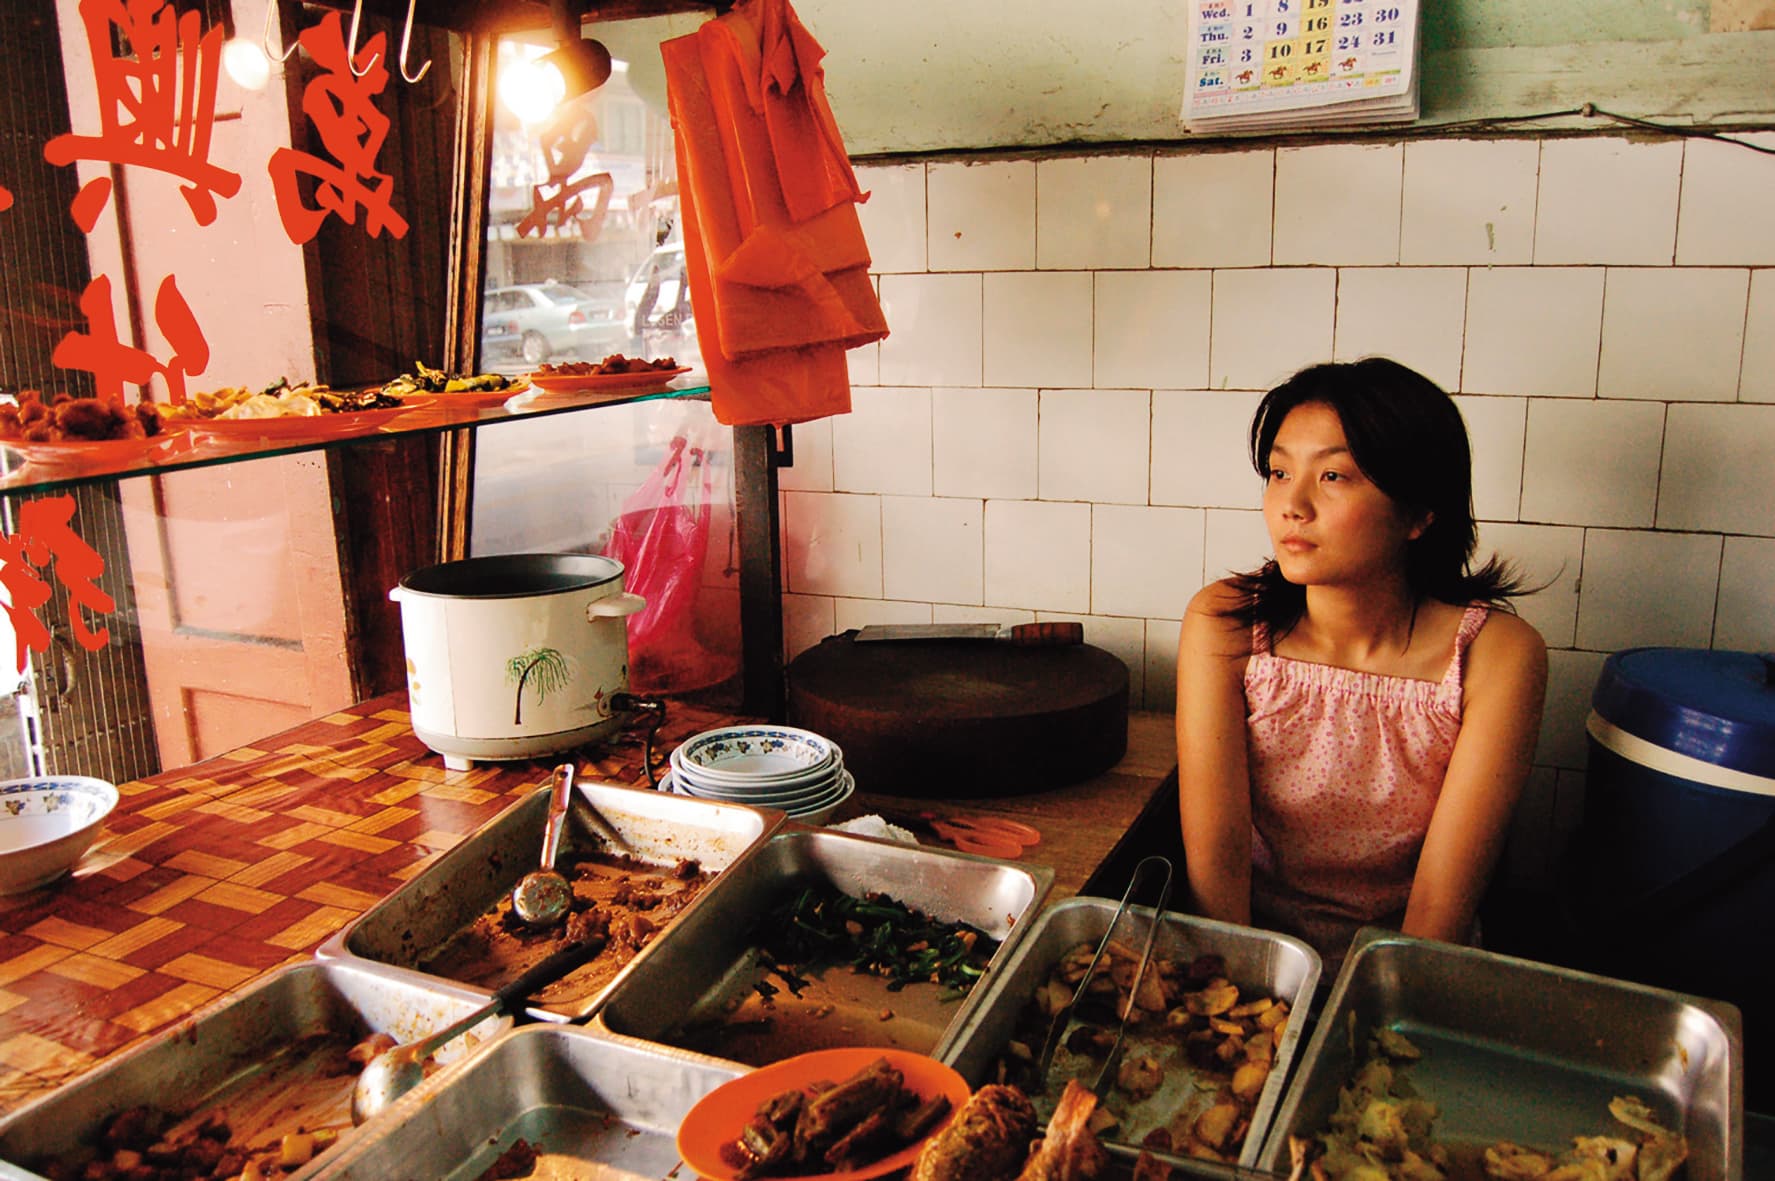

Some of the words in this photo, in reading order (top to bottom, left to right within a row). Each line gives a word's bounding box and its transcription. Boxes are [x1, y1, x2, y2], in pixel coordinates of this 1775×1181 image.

[1202, 8, 1230, 19] Wed.
[1246, 4, 1253, 16] 1
[1278, 0, 1289, 12] 8
[1200, 32, 1229, 42] Thu.
[1243, 26, 1253, 39] 2
[1276, 22, 1288, 36] 9
[1307, 17, 1328, 31] 16
[1340, 12, 1363, 26] 23
[1375, 8, 1399, 22] 30
[1202, 54, 1225, 65] Fri.
[1241, 49, 1252, 62] 3
[1271, 44, 1291, 58] 10
[1305, 40, 1326, 54] 17
[1338, 35, 1360, 49] 24
[1373, 31, 1395, 45] 31
[1199, 77, 1224, 87] Sat.
[642, 312, 682, 327] LSEN
